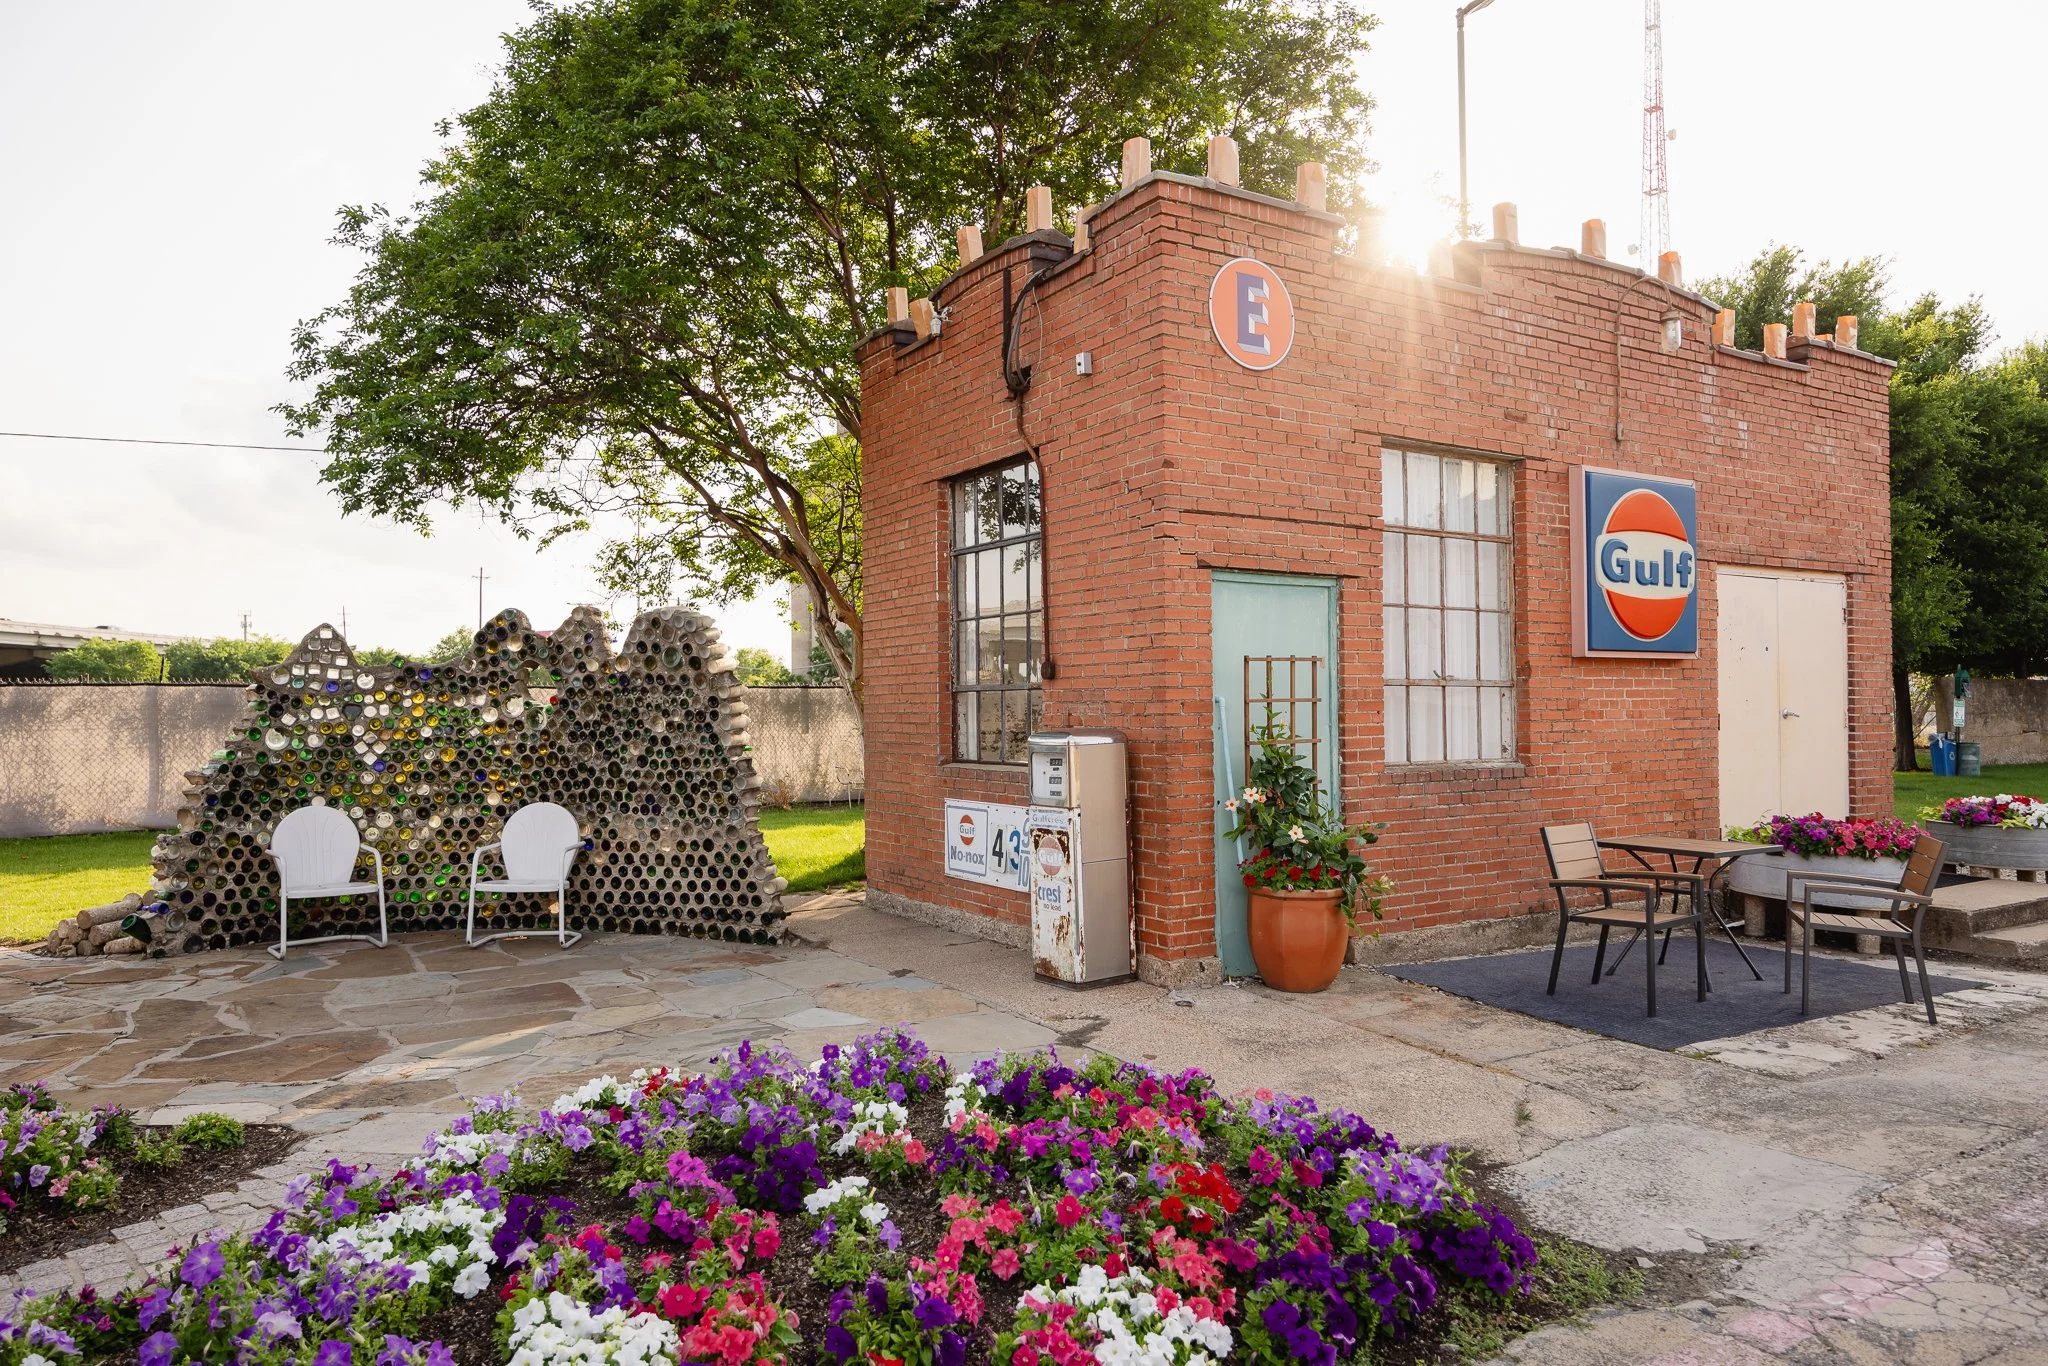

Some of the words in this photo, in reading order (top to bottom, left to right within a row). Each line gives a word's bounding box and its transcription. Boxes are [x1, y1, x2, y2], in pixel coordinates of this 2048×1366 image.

[1236, 271, 1270, 356] E
[1601, 538, 1693, 588] Gulf
[960, 824, 975, 836] Gulf
[1038, 885, 1062, 904] crest
[1050, 902, 1062, 912] lead
